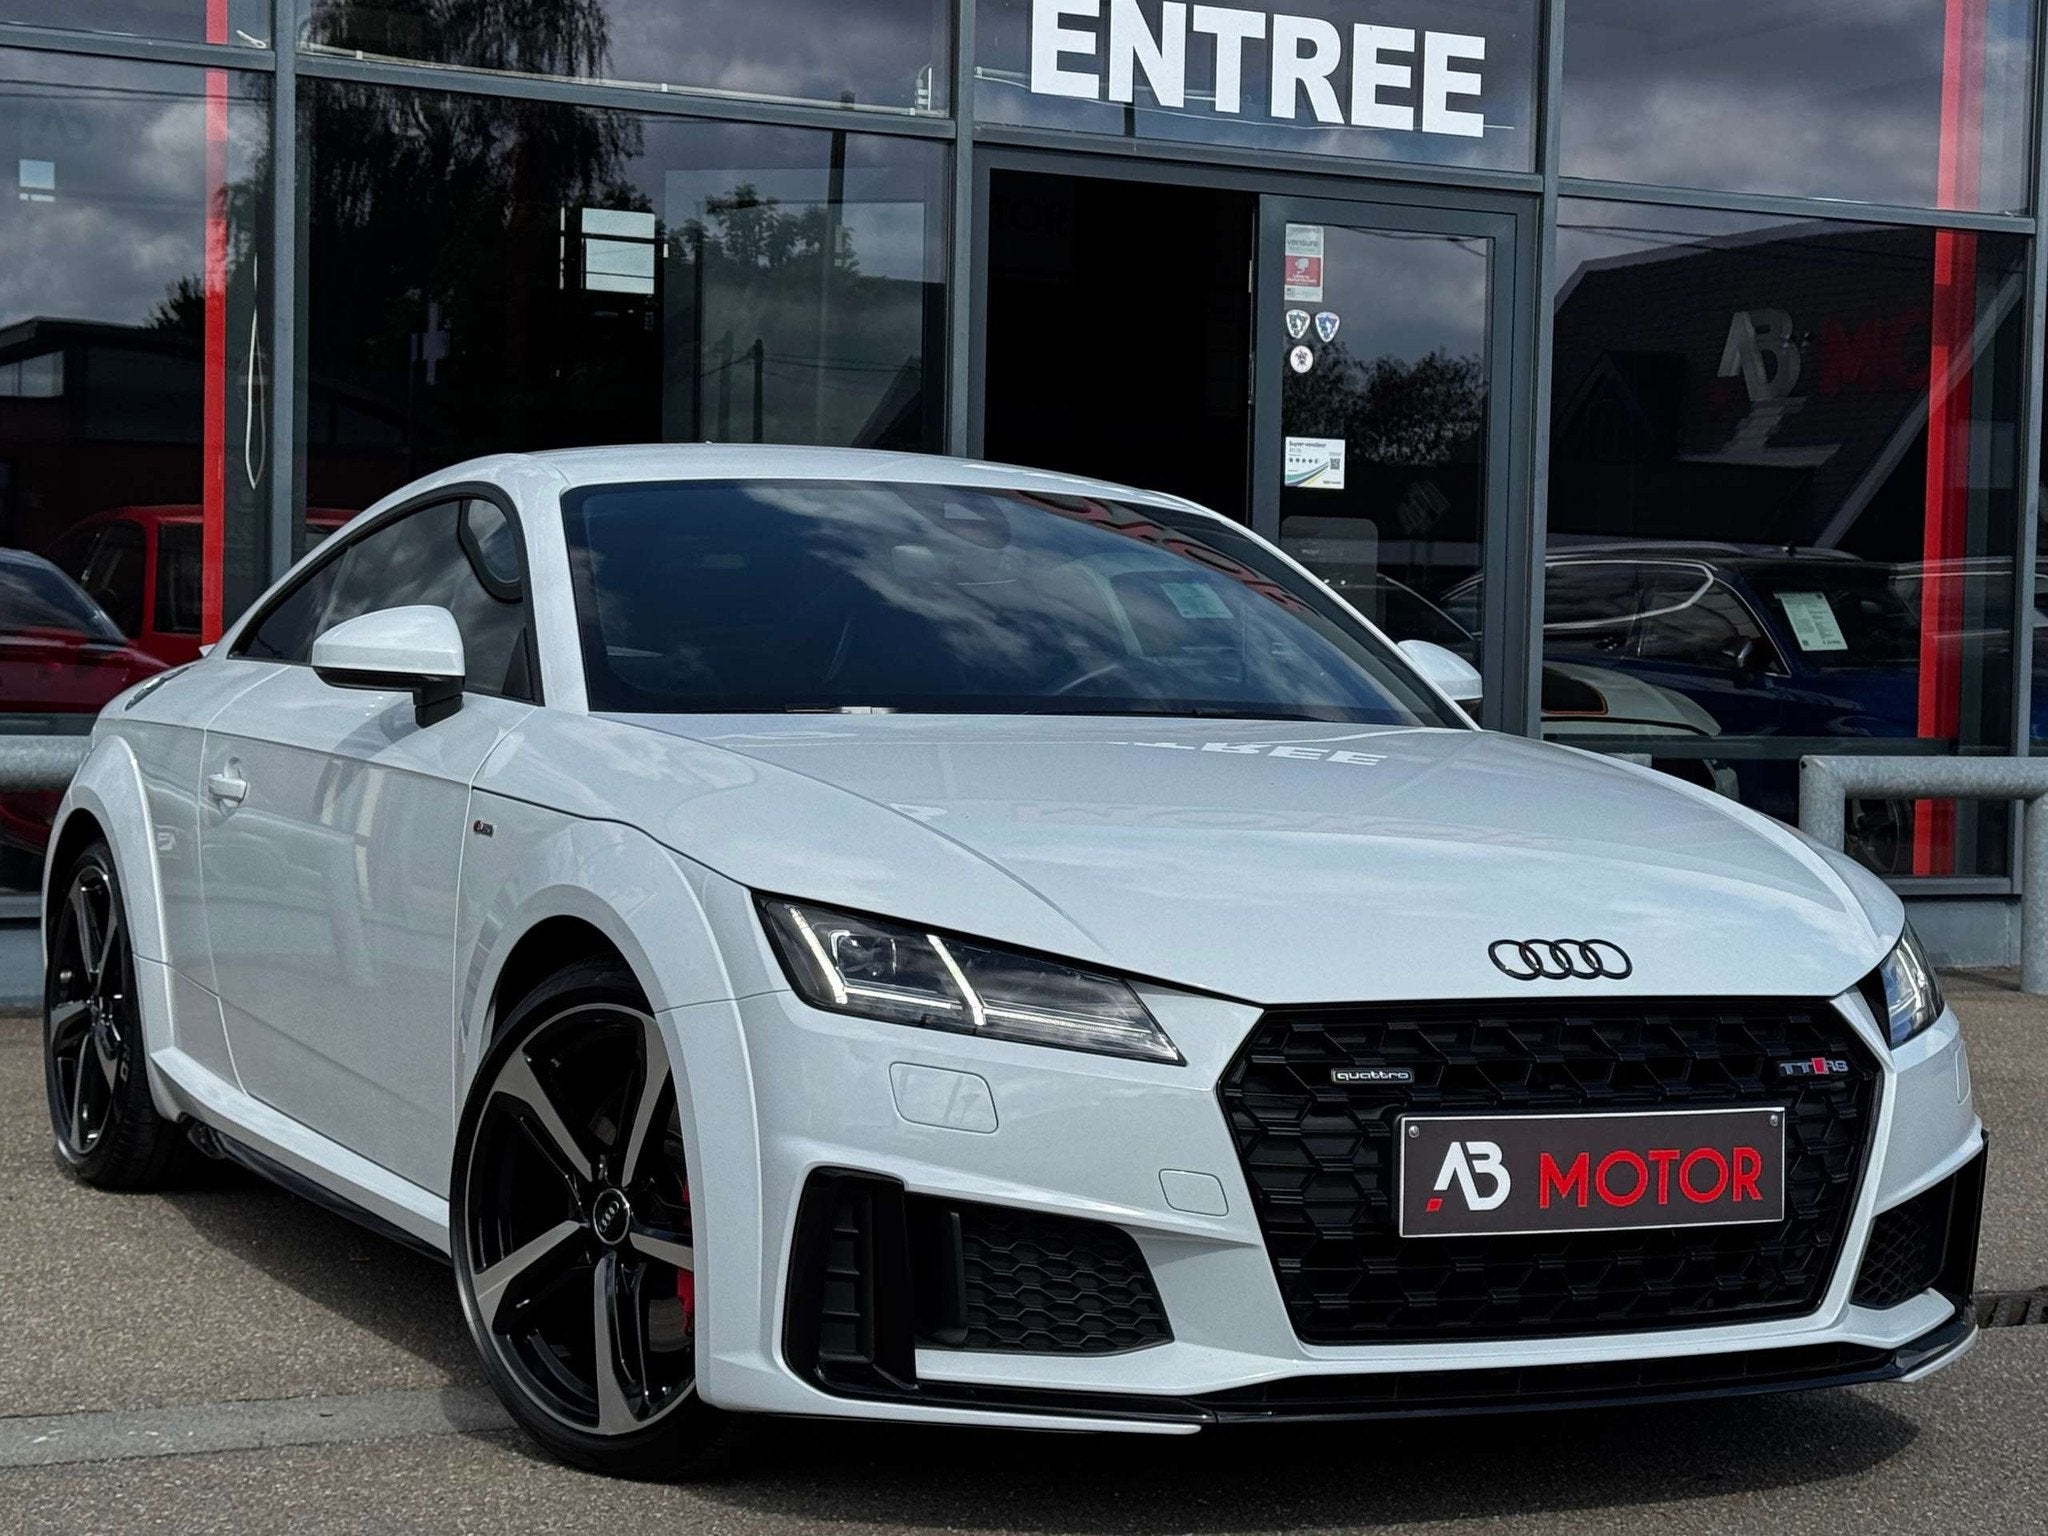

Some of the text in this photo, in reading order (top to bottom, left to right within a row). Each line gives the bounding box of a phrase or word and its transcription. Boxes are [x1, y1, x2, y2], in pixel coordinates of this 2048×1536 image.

[1029, 0, 1486, 138] ENTREE
[1336, 1070, 1409, 1082] quattro
[1427, 1140, 1765, 1212] AB MOTOR
